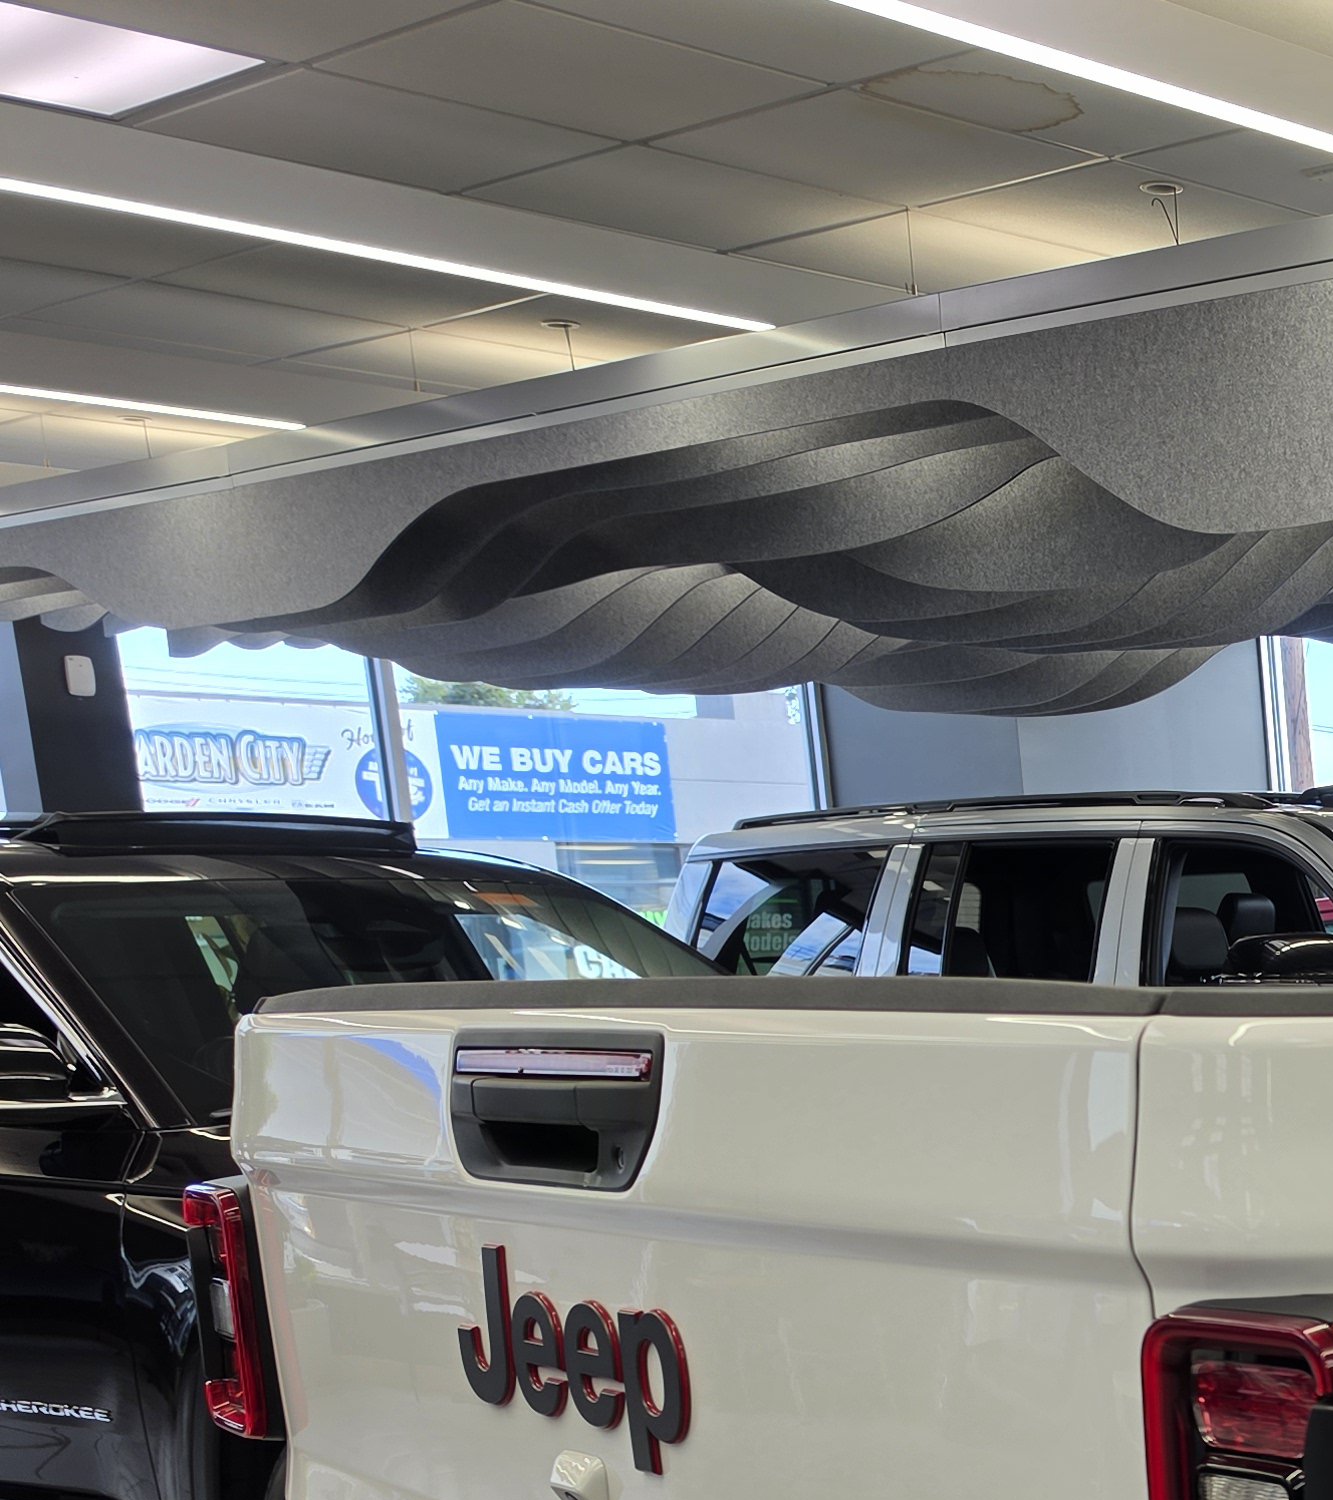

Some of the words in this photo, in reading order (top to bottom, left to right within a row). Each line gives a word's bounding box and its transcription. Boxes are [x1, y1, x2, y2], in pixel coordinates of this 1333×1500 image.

[136, 730, 237, 783] ARDEN
[236, 730, 307, 785] CITY
[450, 745, 502, 771] WE
[510, 747, 572, 773] BUY
[582, 750, 662, 777] CARS
[458, 776, 485, 794] Any
[488, 777, 528, 793] Make.
[531, 778, 556, 795] Any
[559, 778, 602, 795] Model.
[605, 781, 629, 798] Any
[632, 781, 662, 796] Year.
[468, 797, 491, 812] Get
[493, 801, 509, 812] an
[512, 798, 556, 813] Instant
[558, 799, 589, 814] Cash
[591, 799, 622, 815] Offer
[624, 800, 658, 818] Today
[747, 911, 793, 929] akes
[457, 1243, 693, 1476] Jeep
[0, 1400, 112, 1422] HEROKEE
